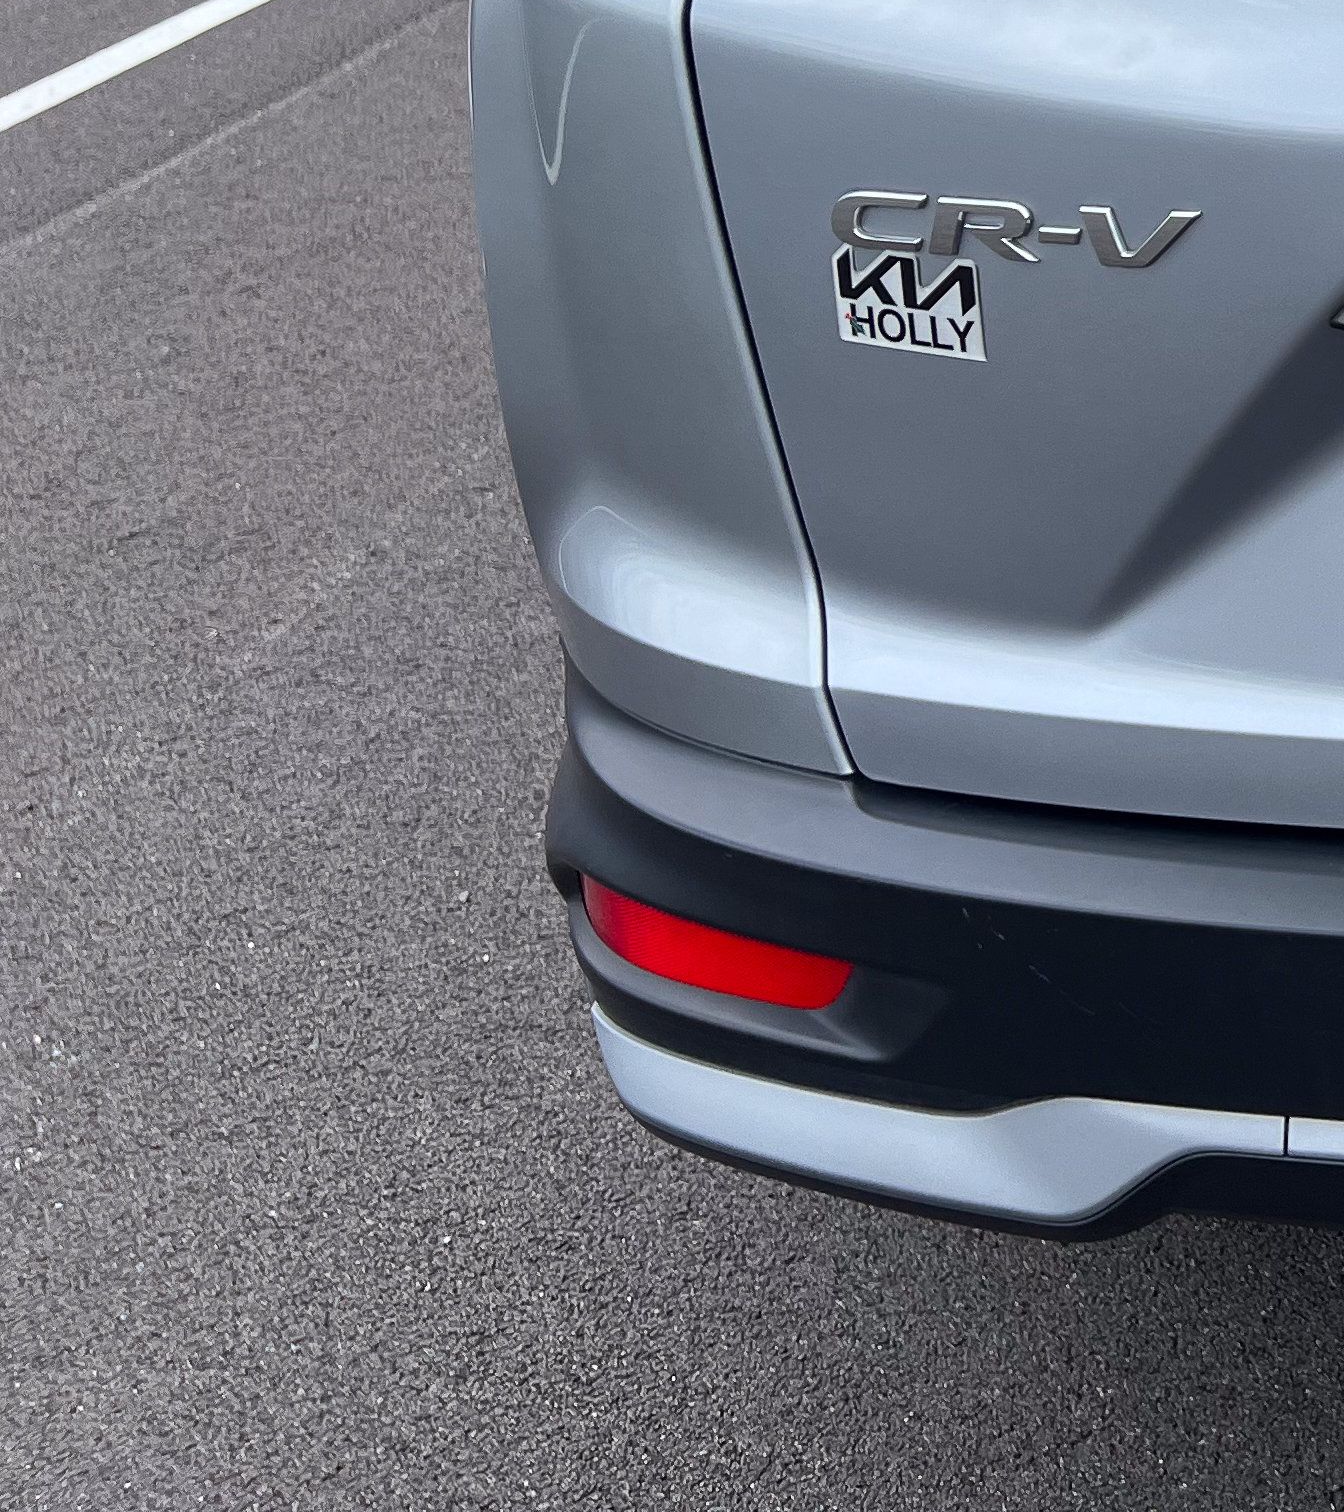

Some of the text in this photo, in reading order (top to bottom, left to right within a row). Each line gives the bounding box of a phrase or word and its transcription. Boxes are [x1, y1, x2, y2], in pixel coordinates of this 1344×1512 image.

[831, 189, 1202, 268] CR-V
[836, 247, 977, 317] KIA
[845, 302, 975, 353] HOLLY
